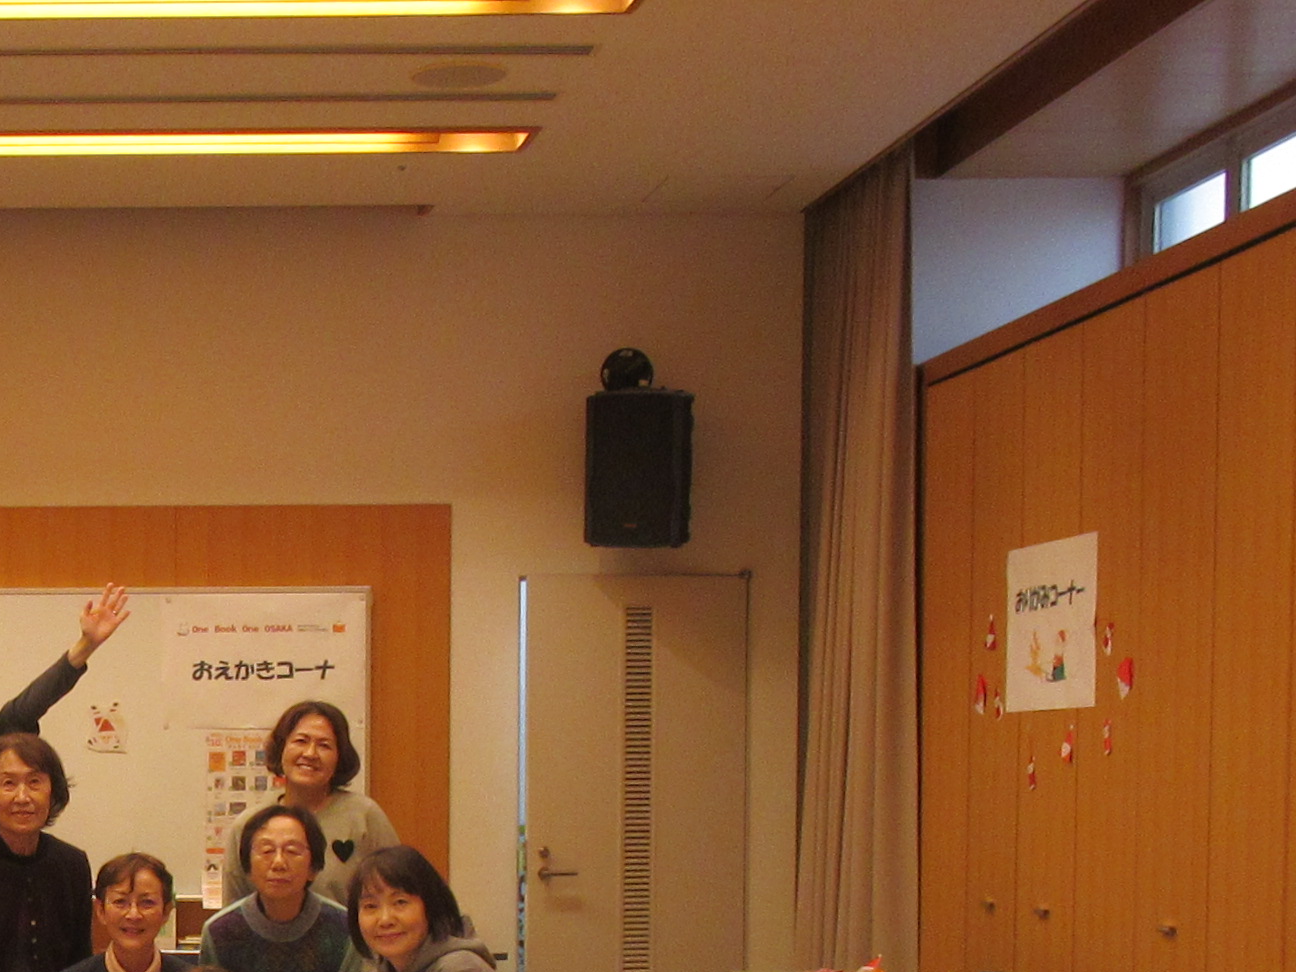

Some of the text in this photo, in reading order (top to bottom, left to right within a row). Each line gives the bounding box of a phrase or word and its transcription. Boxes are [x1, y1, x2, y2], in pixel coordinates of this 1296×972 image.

[192, 624, 209, 633] One
[214, 623, 237, 633] Book
[242, 624, 259, 633] One
[265, 624, 294, 633] OSAKA
[191, 658, 336, 681] おえかきコーナ
